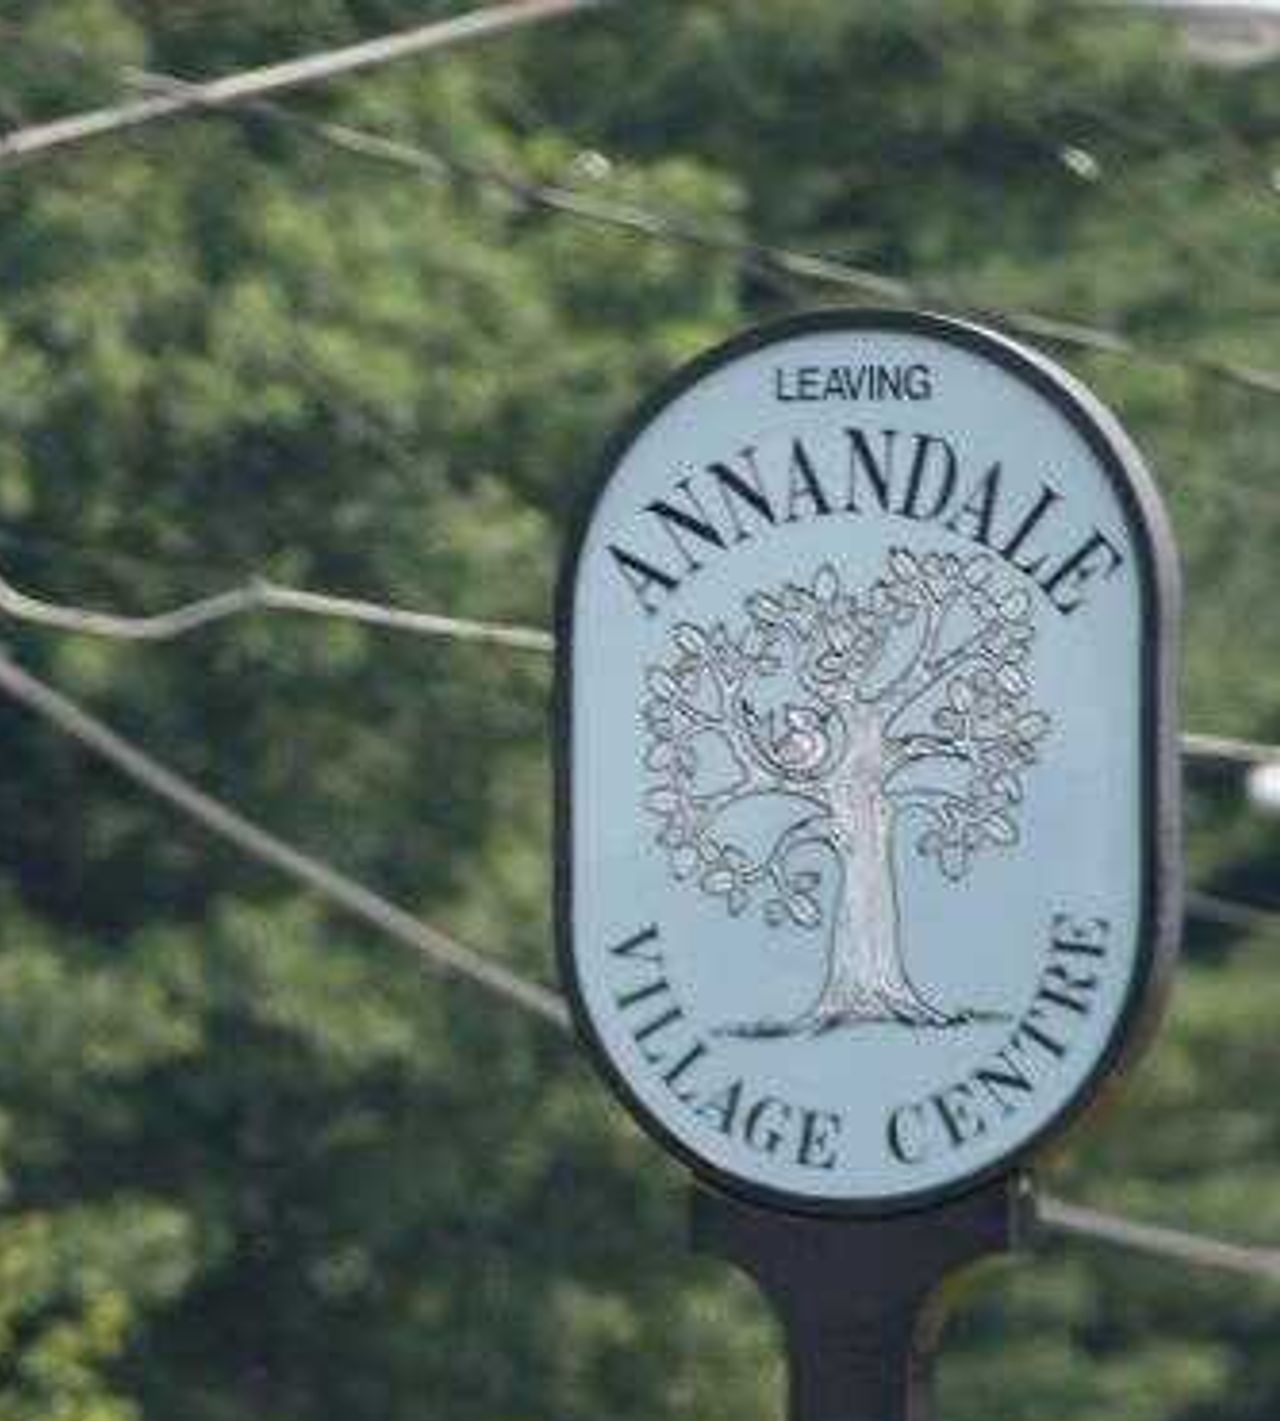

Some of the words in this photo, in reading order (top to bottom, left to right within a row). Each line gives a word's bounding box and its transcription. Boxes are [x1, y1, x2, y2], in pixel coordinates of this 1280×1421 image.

[775, 364, 933, 402] LEAVING
[604, 426, 1124, 616] ANNANDALE
[607, 922, 842, 1171] VILLAGE
[885, 910, 1112, 1166] CENTRE
